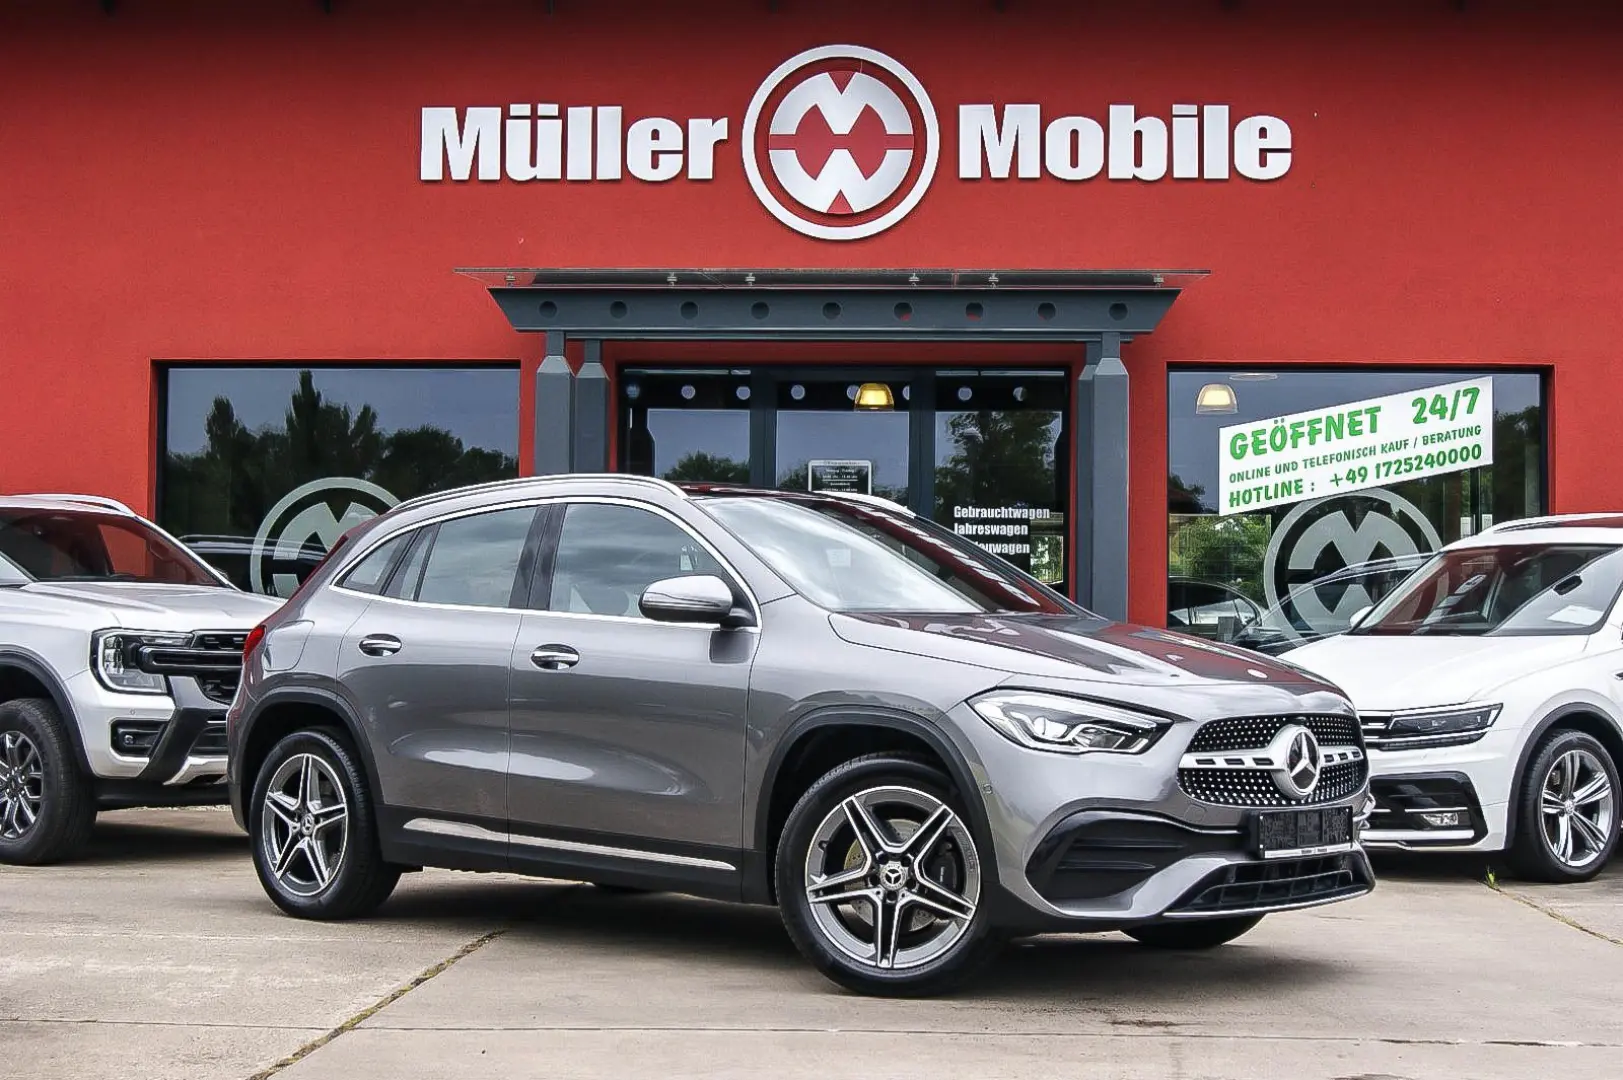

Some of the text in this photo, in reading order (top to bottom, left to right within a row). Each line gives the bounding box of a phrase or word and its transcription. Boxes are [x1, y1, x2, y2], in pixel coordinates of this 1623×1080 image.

[420, 103, 1293, 182] Müller Mobile
[1229, 386, 1481, 461] GEÖFFNET 24/7
[1229, 466, 1271, 484] ONLINE
[1274, 461, 1298, 475] UND
[1302, 445, 1377, 470] TELEFONISCH
[1380, 439, 1409, 455] KAUF
[1422, 425, 1482, 446] BERATUNG
[1229, 478, 1304, 508] HOTLINE
[1329, 465, 1369, 488] +49
[1375, 443, 1482, 480] 1725240000
[954, 506, 1050, 519] Gebrauchtwagen
[954, 523, 1028, 536] Jahreswagen
